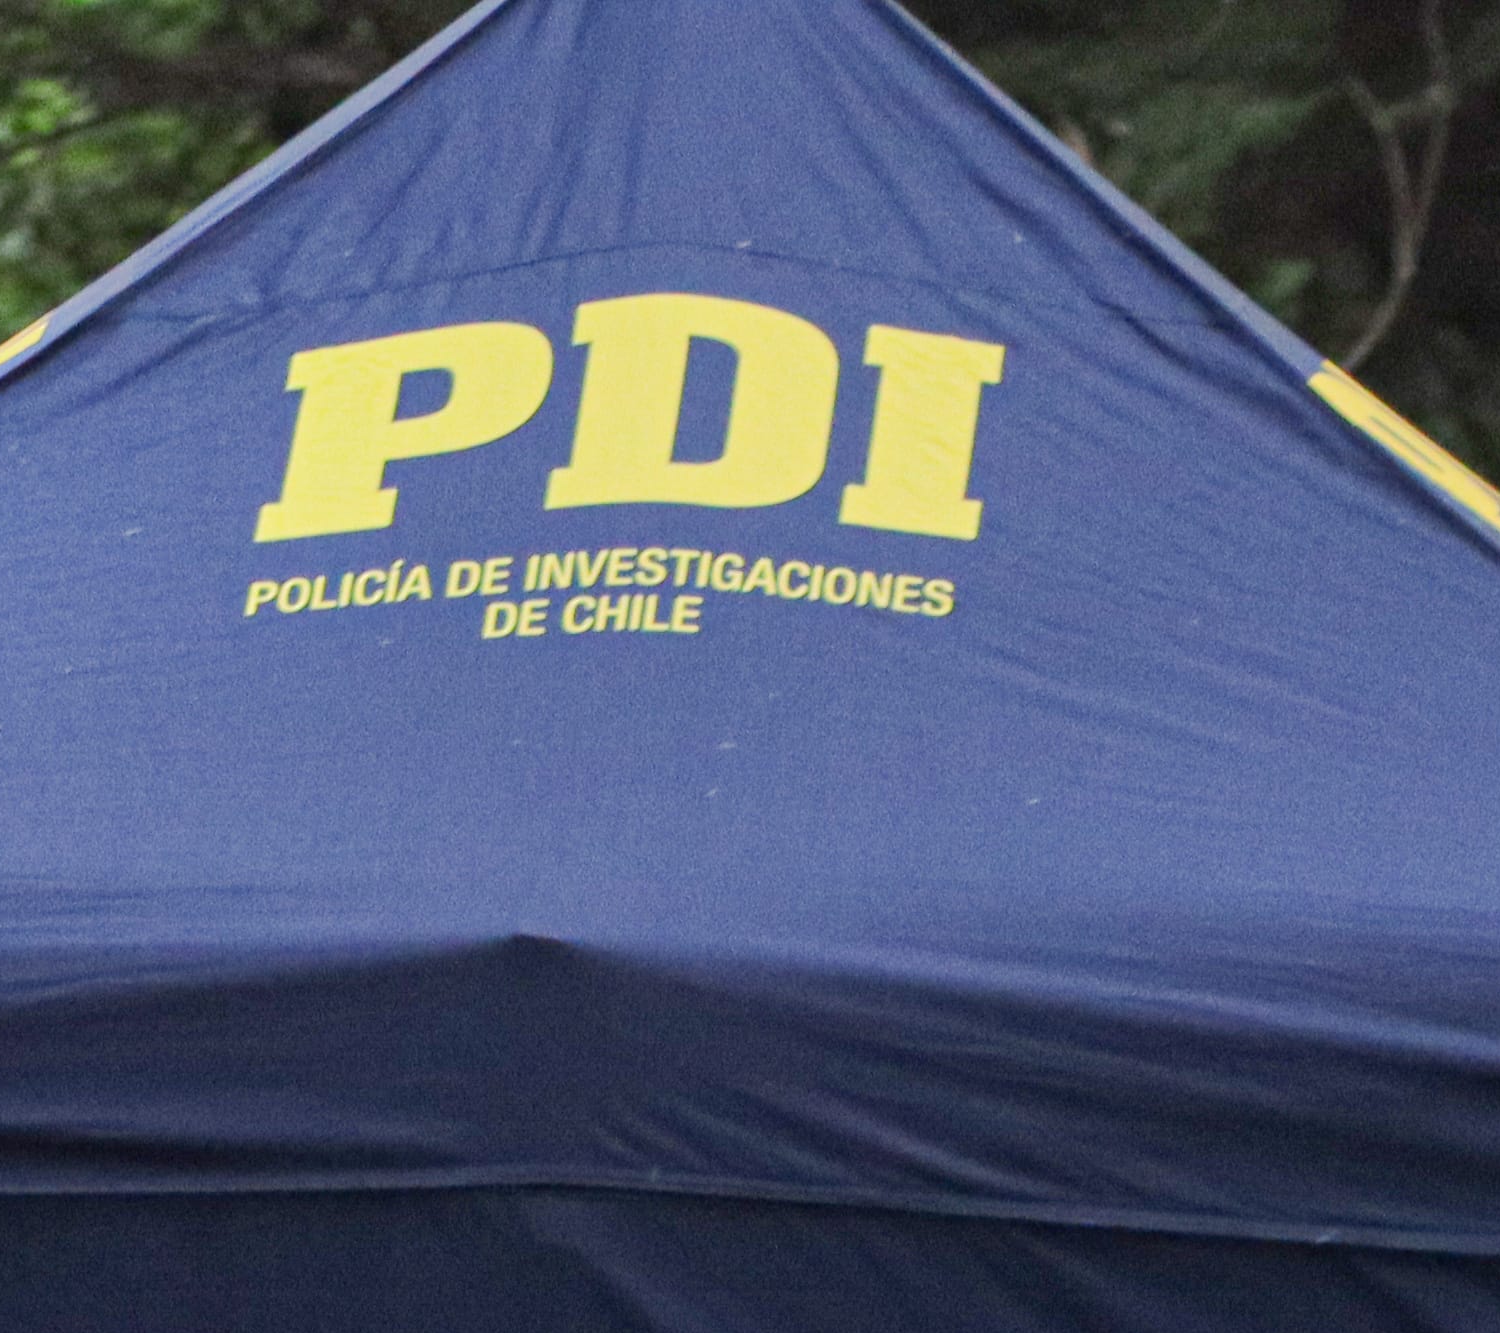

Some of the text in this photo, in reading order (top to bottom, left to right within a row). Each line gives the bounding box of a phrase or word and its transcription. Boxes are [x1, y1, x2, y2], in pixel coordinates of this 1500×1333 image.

[253, 291, 1007, 542] PDI
[245, 547, 956, 617] POLICÍA DE INVESTIGACIONES
[482, 595, 702, 639] DE CHILE
